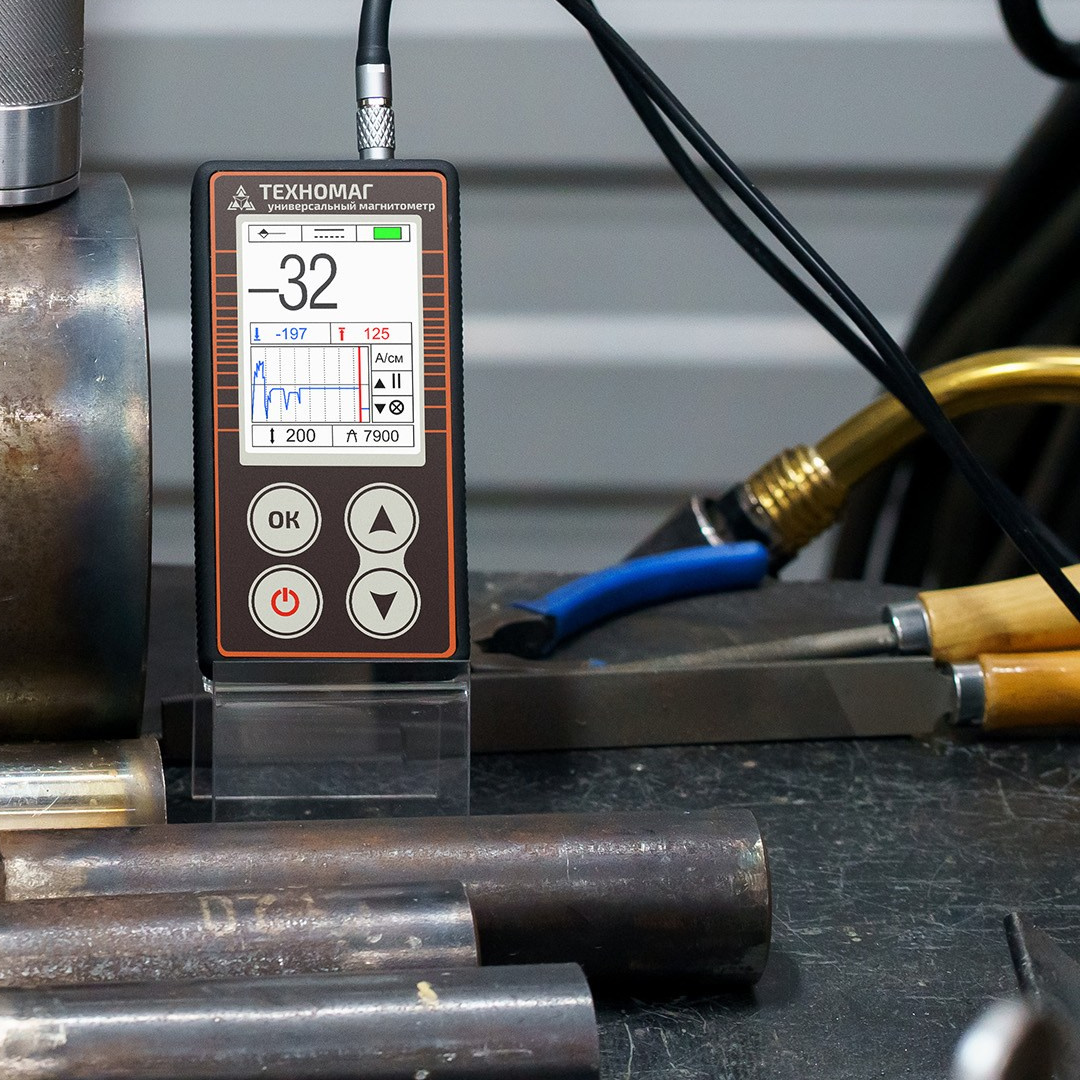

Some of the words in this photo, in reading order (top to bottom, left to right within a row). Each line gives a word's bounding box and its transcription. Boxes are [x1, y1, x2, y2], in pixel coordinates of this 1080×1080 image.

[259, 183, 373, 200] ТЕХНОМАГ
[267, 201, 357, 212] универсальный
[359, 203, 436, 212] магнитометр
[275, 327, 308, 341] -197
[364, 327, 390, 341] 125
[286, 428, 316, 443] 200
[364, 428, 400, 443] 7900
[268, 510, 301, 529] OK
